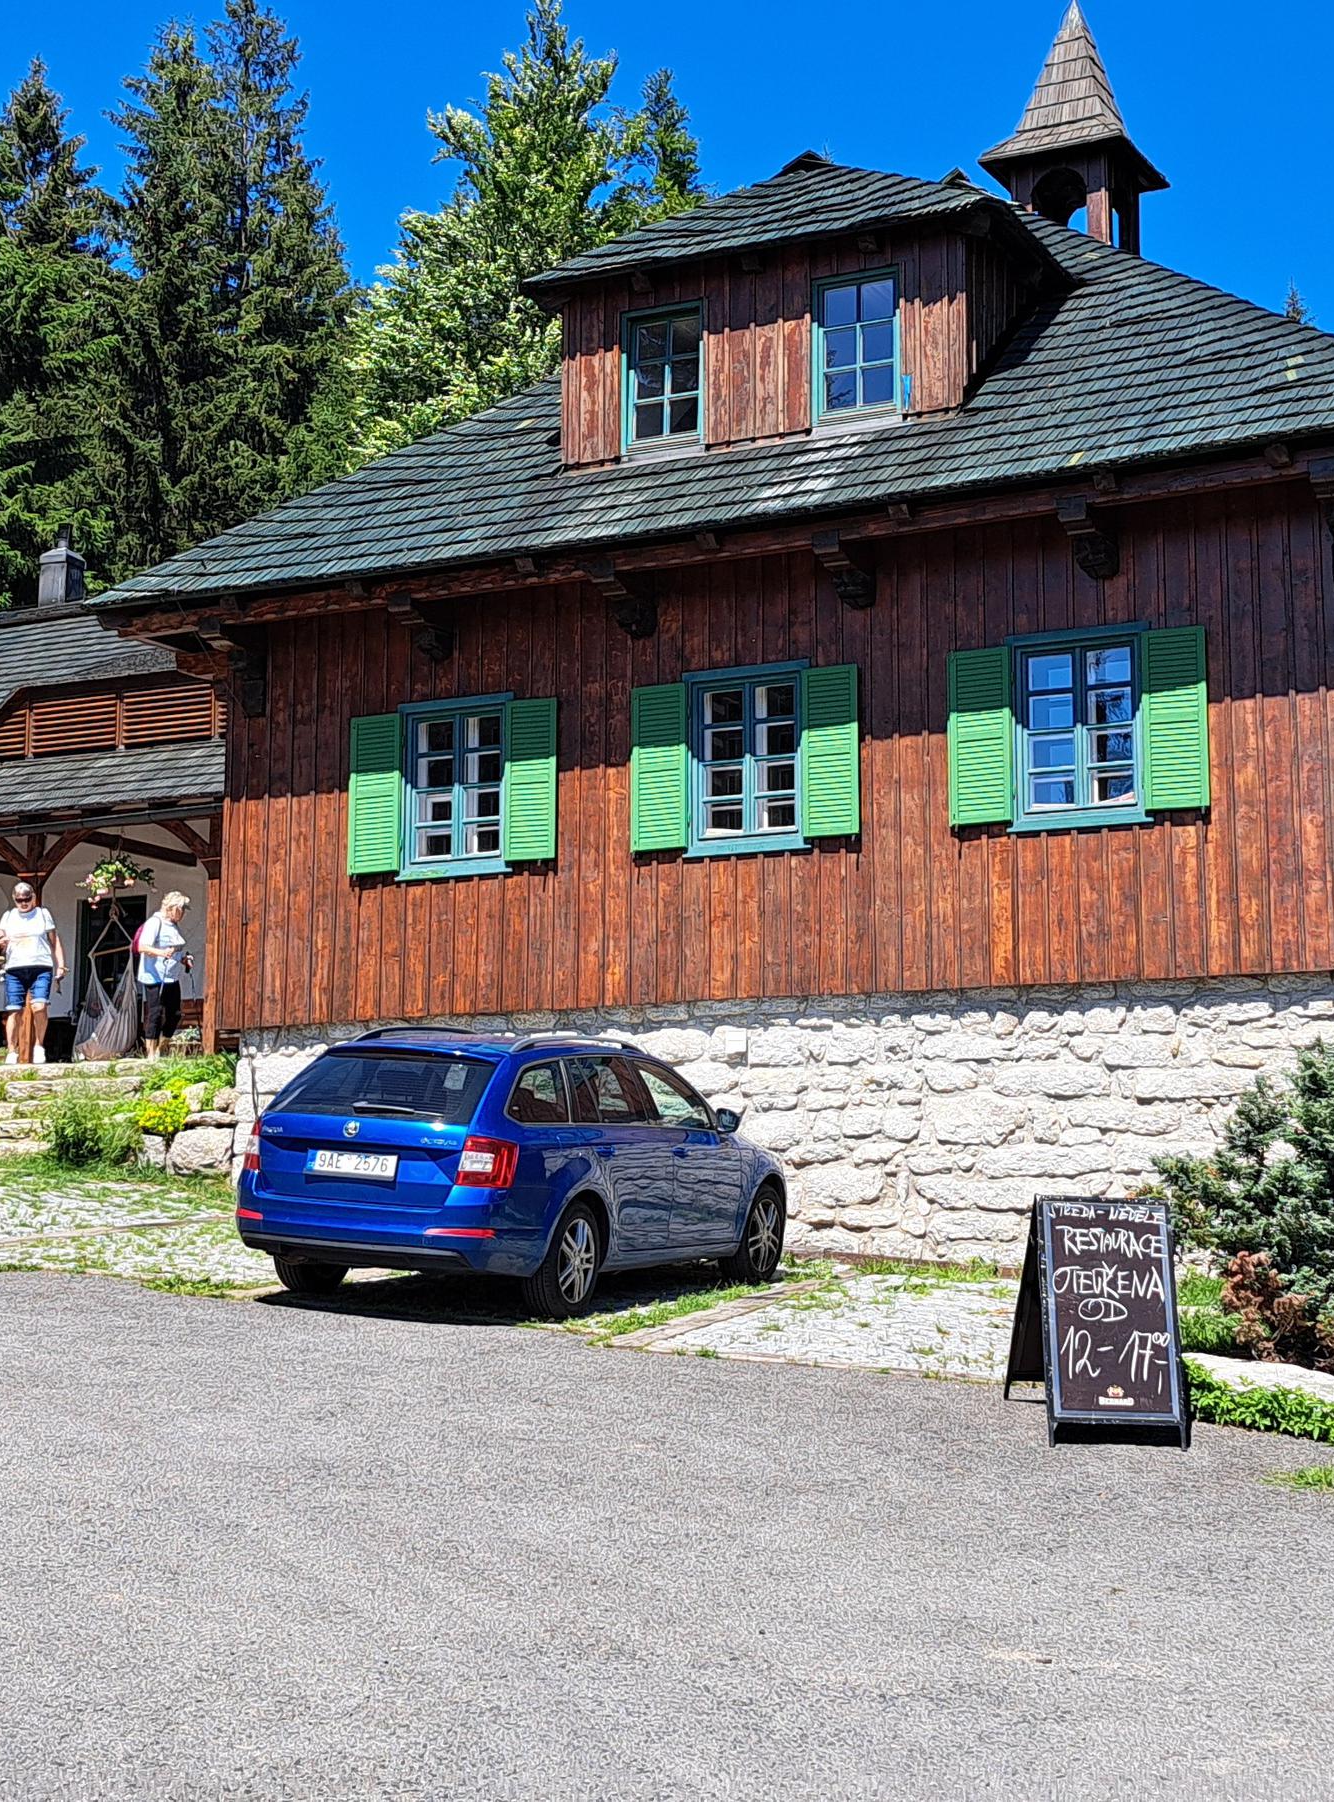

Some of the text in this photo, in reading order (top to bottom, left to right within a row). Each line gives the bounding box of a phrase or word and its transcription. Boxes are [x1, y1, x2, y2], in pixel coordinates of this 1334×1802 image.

[318, 1152, 389, 1173] 9AE 2576
[1055, 1225, 1167, 1259] RESTAURACE
[1052, 1261, 1165, 1302] OTEVŘENA
[1078, 1297, 1128, 1322] OD
